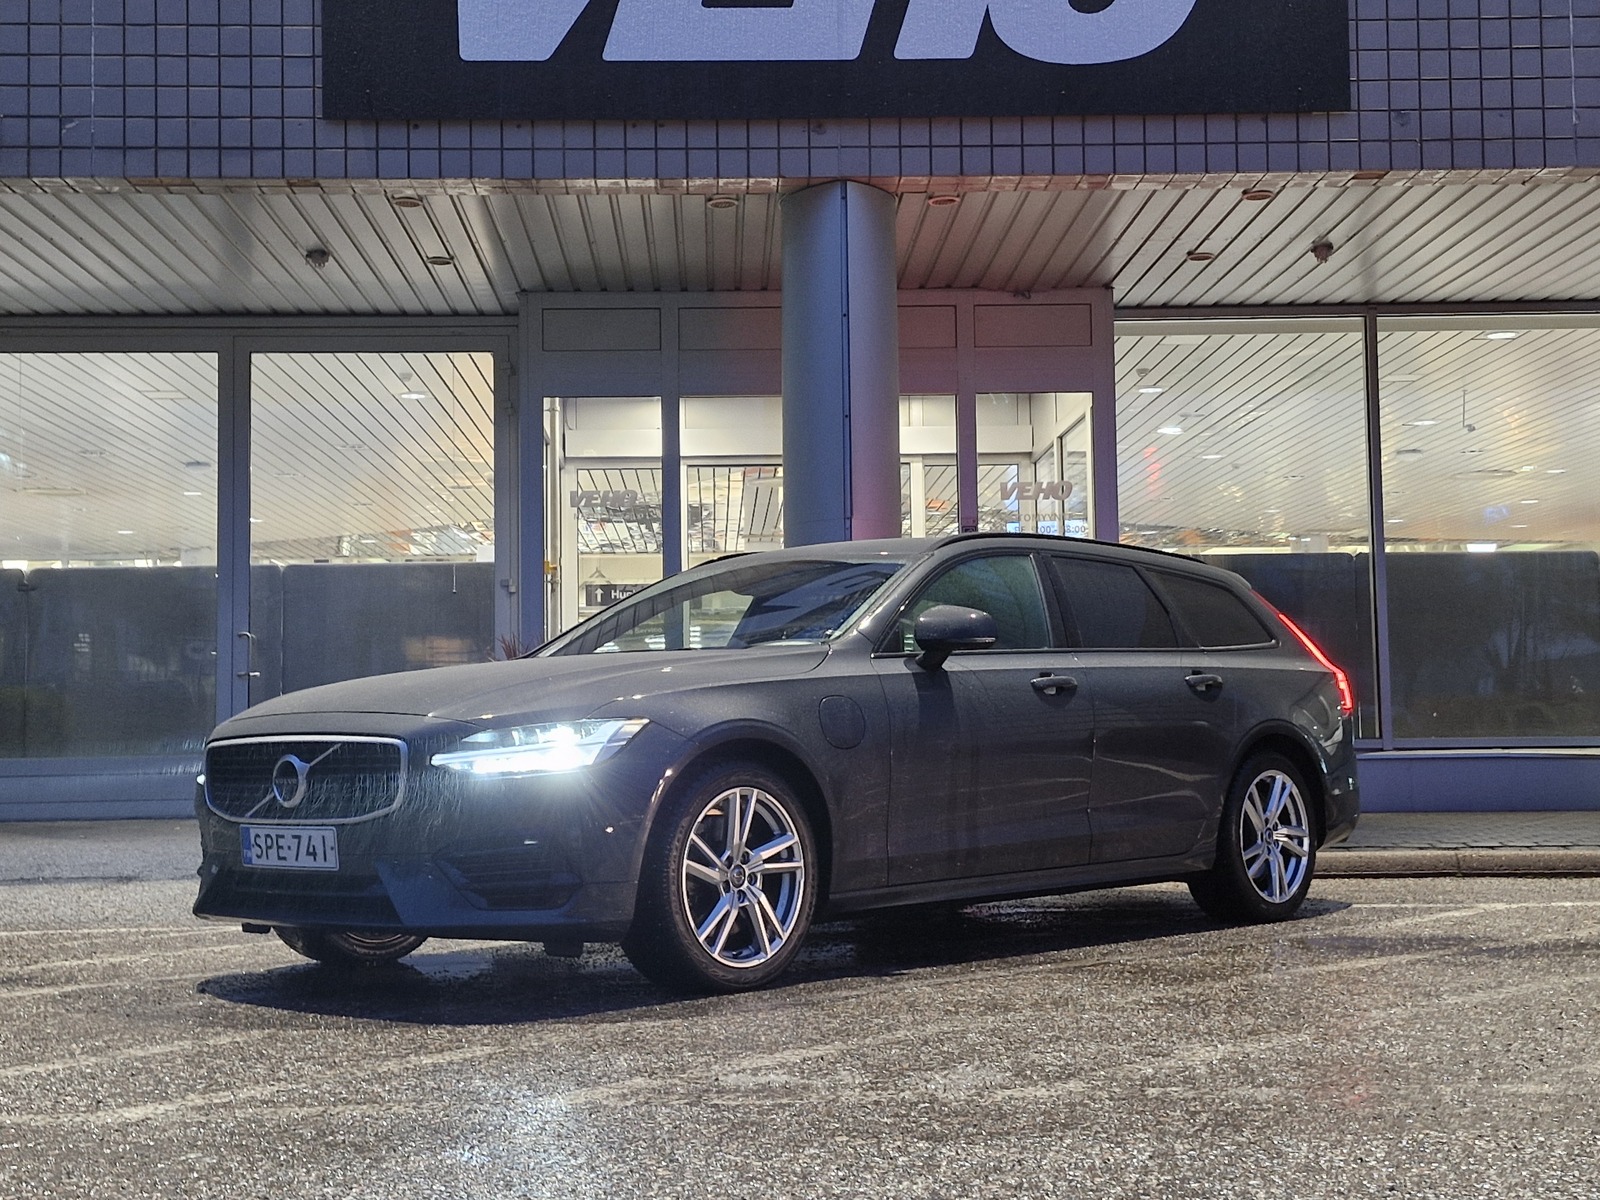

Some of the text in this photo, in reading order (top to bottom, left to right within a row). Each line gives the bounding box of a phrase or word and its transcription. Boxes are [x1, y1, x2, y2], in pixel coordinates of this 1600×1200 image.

[570, 490, 637, 507] VEHO
[1000, 481, 1072, 500] VEHO
[611, 589, 636, 600] Hu
[254, 833, 327, 862] SPE-741
